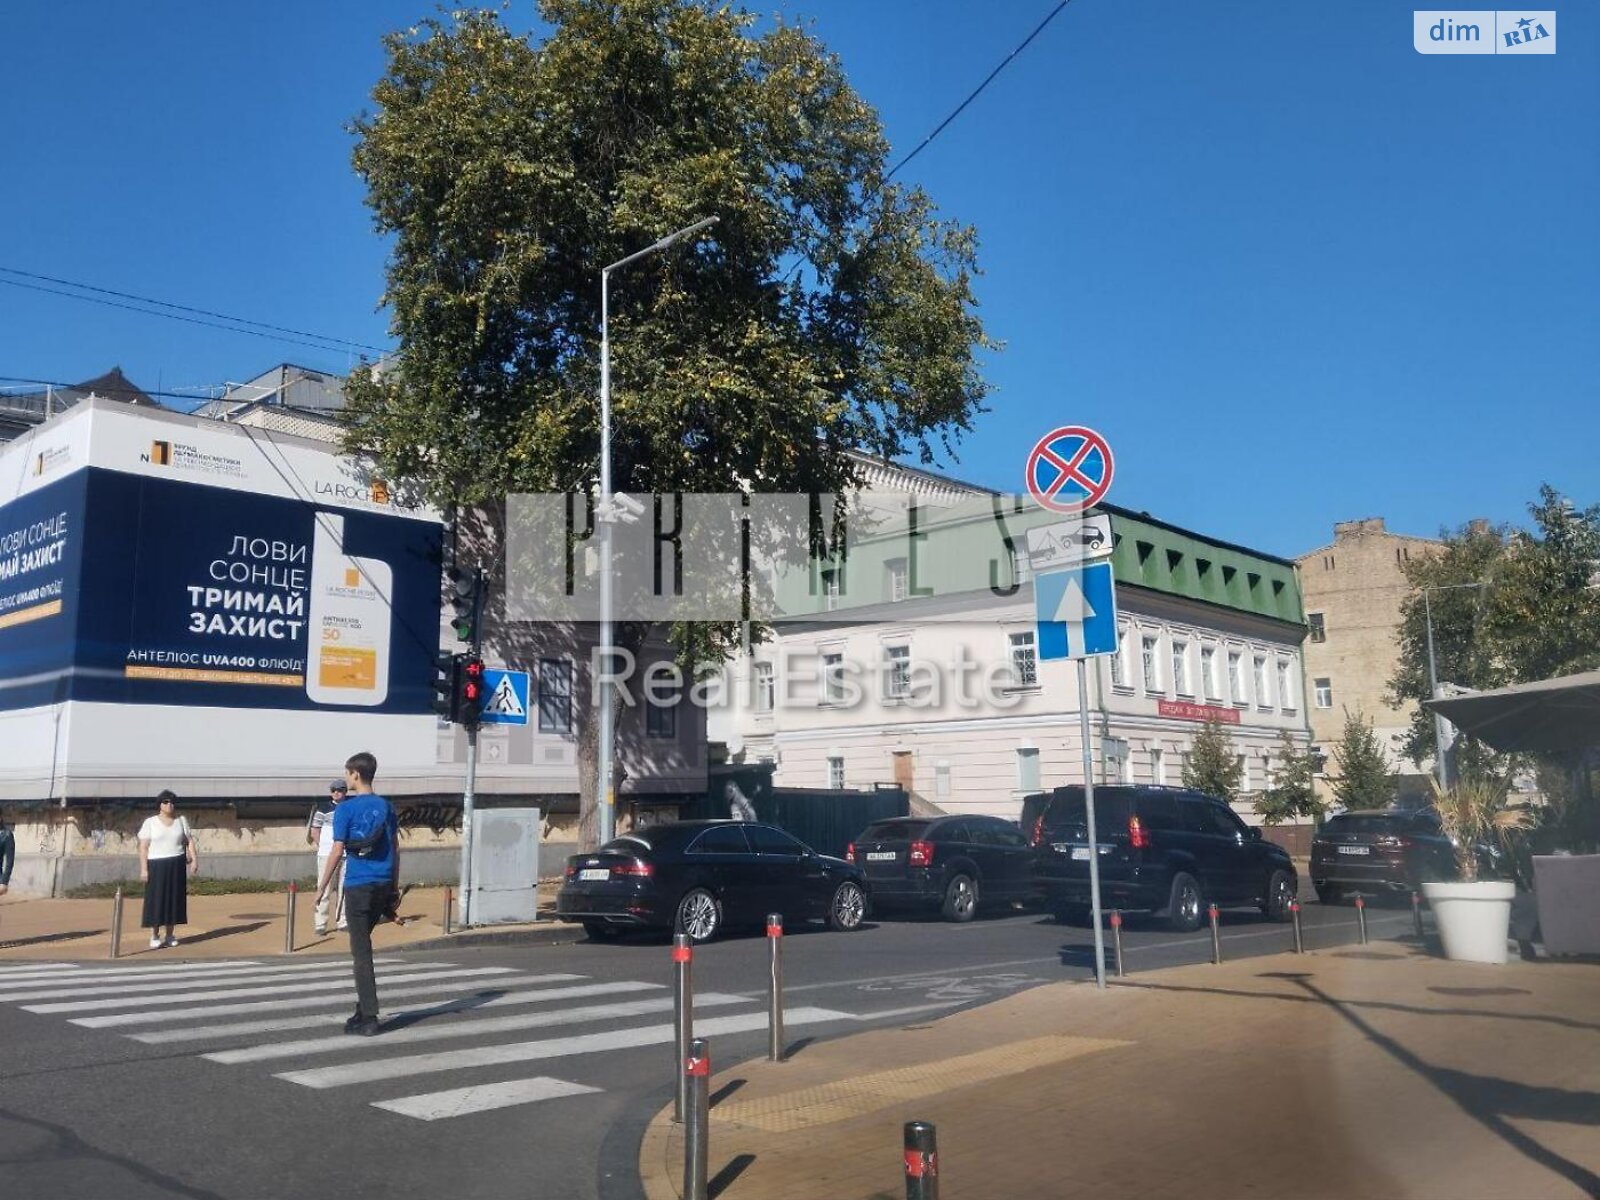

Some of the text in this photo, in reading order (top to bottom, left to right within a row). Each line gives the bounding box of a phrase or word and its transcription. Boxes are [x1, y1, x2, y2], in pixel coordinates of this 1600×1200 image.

[314, 480, 333, 496] LA
[227, 535, 307, 564] ЛОВИ
[186, 585, 305, 617] ТРИМАЙ
[187, 611, 303, 641] ЗАХИСТ
[322, 629, 341, 641] 50
[126, 649, 199, 665] АНТЕЛІОС
[202, 653, 256, 668] UVA400
